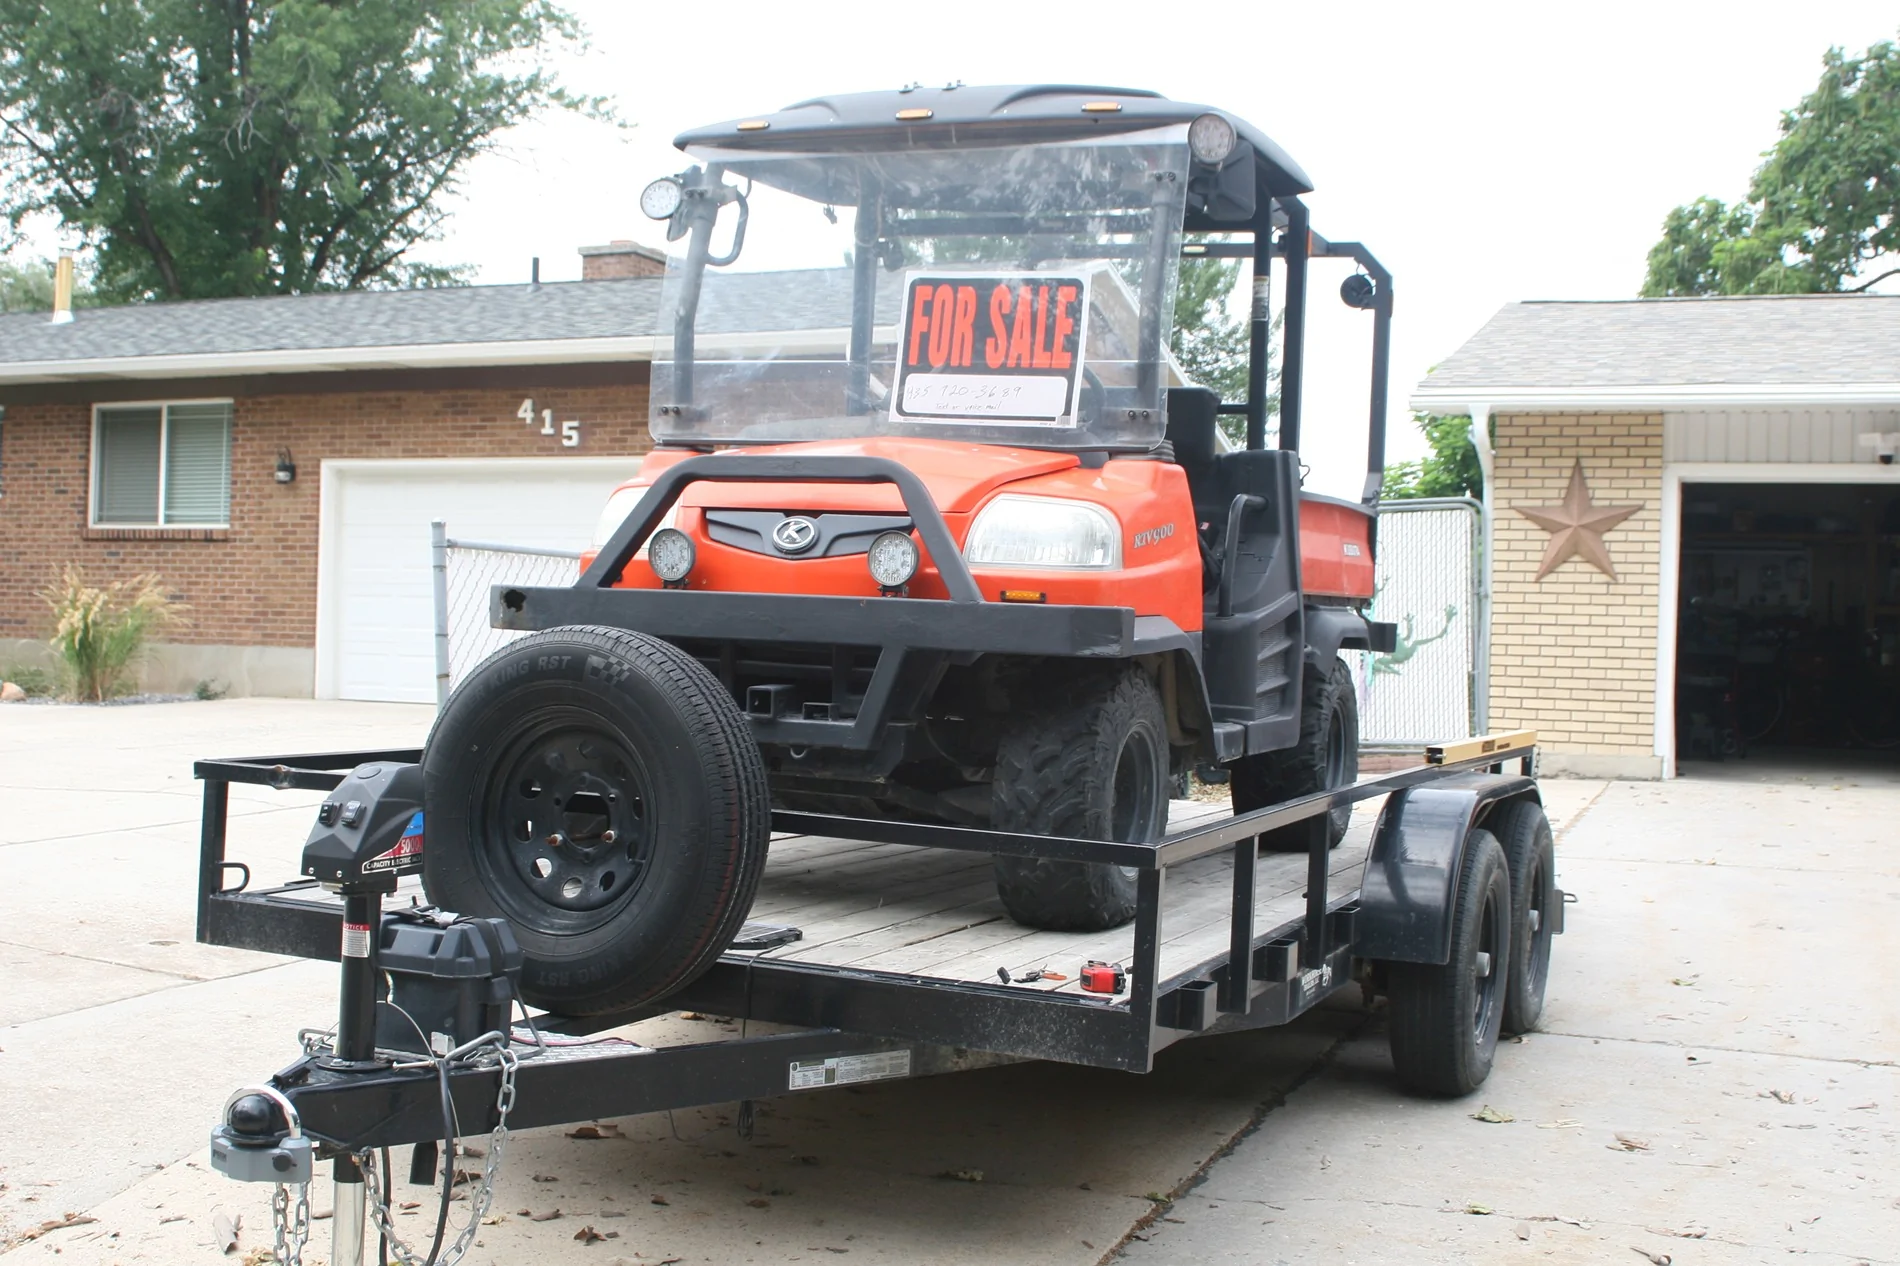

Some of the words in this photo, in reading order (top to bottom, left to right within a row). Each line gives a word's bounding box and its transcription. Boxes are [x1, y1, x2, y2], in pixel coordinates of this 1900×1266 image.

[908, 284, 978, 369] FOR
[984, 284, 1077, 369] SALE
[517, 398, 579, 447] 415
[1133, 523, 1174, 549] RTV900
[489, 659, 530, 689] KING
[537, 655, 572, 671] RST
[366, 860, 391, 869] CAPACITY
